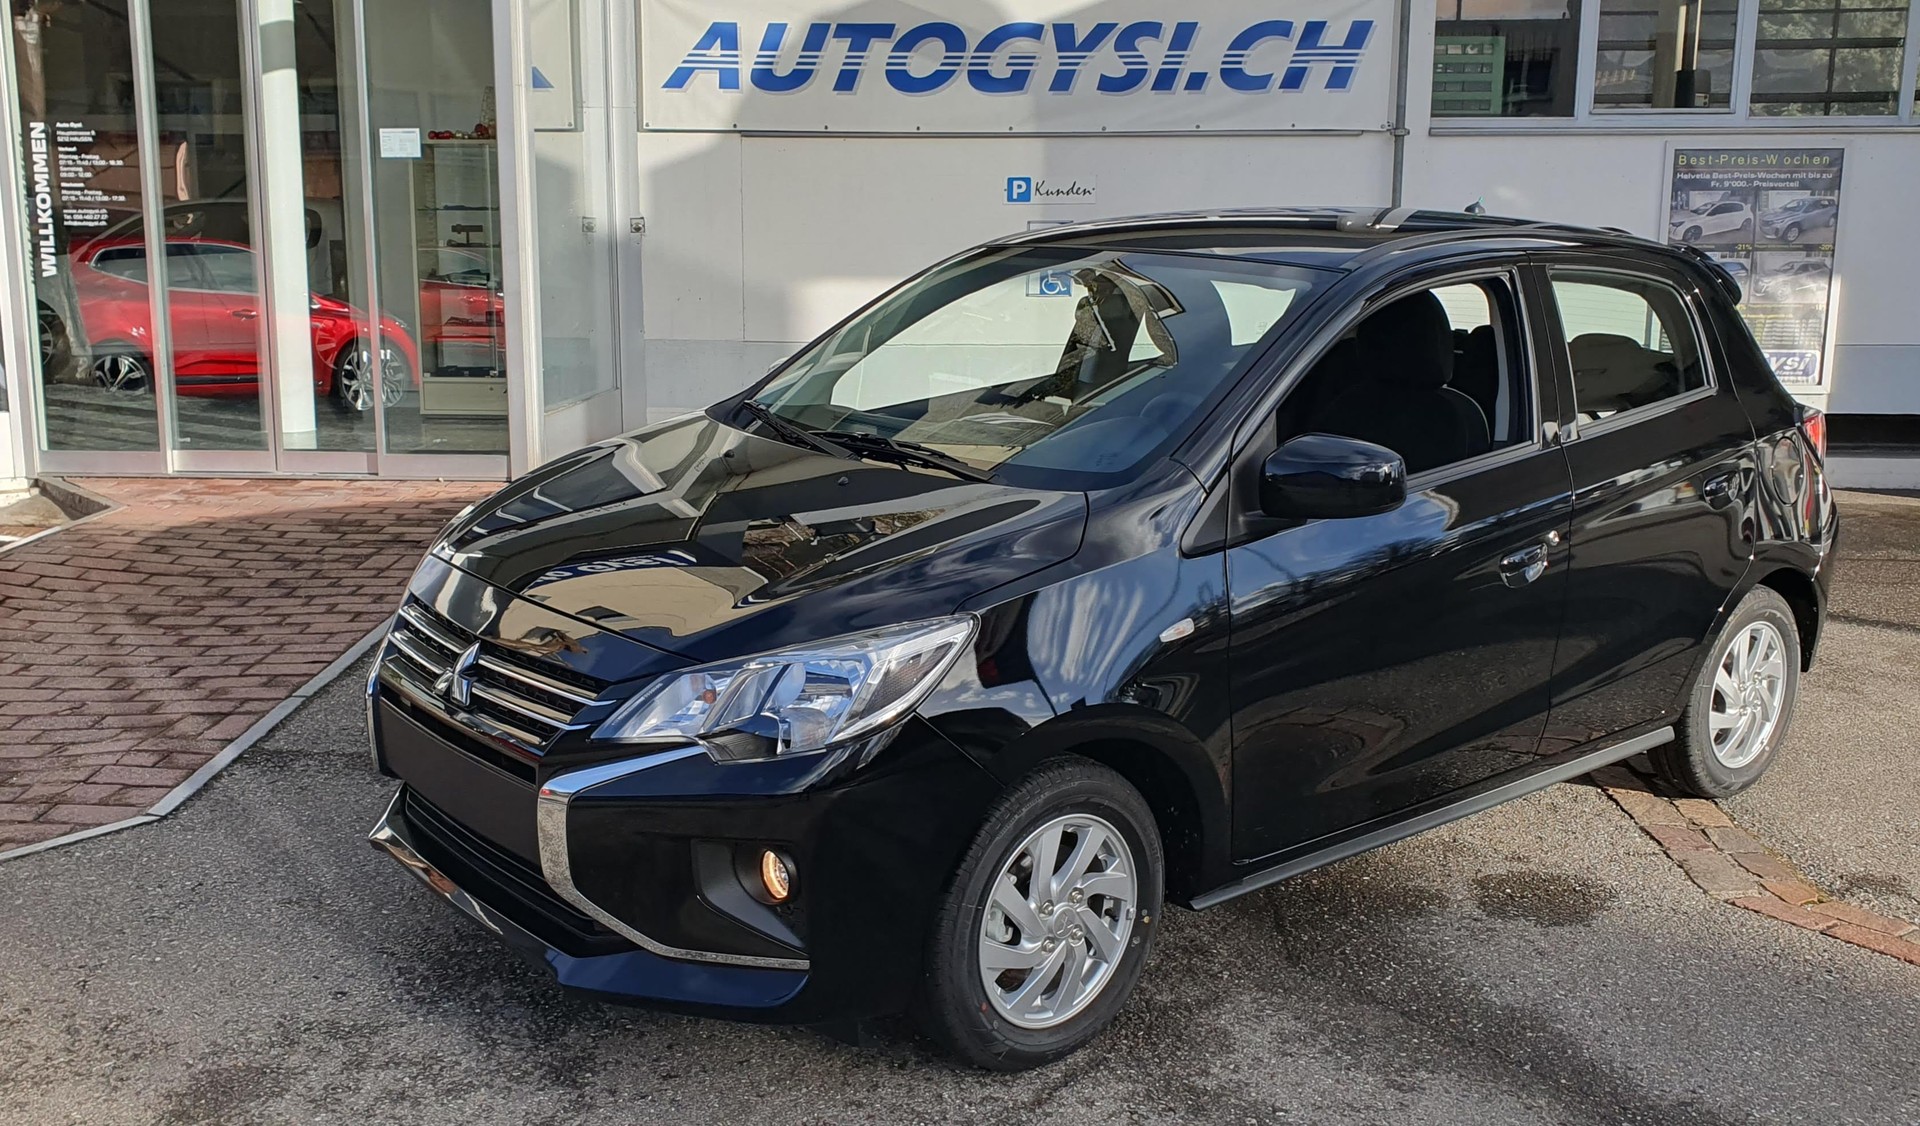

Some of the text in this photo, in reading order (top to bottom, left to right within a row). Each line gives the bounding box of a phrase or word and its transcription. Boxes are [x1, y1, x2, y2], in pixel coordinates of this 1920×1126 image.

[661, 20, 1375, 94] AUTOGYSI.CH
[30, 122, 57, 277] WILLKOMMEN
[1012, 180, 1092, 199] P Kunden
[1764, 353, 1812, 373] ysi
